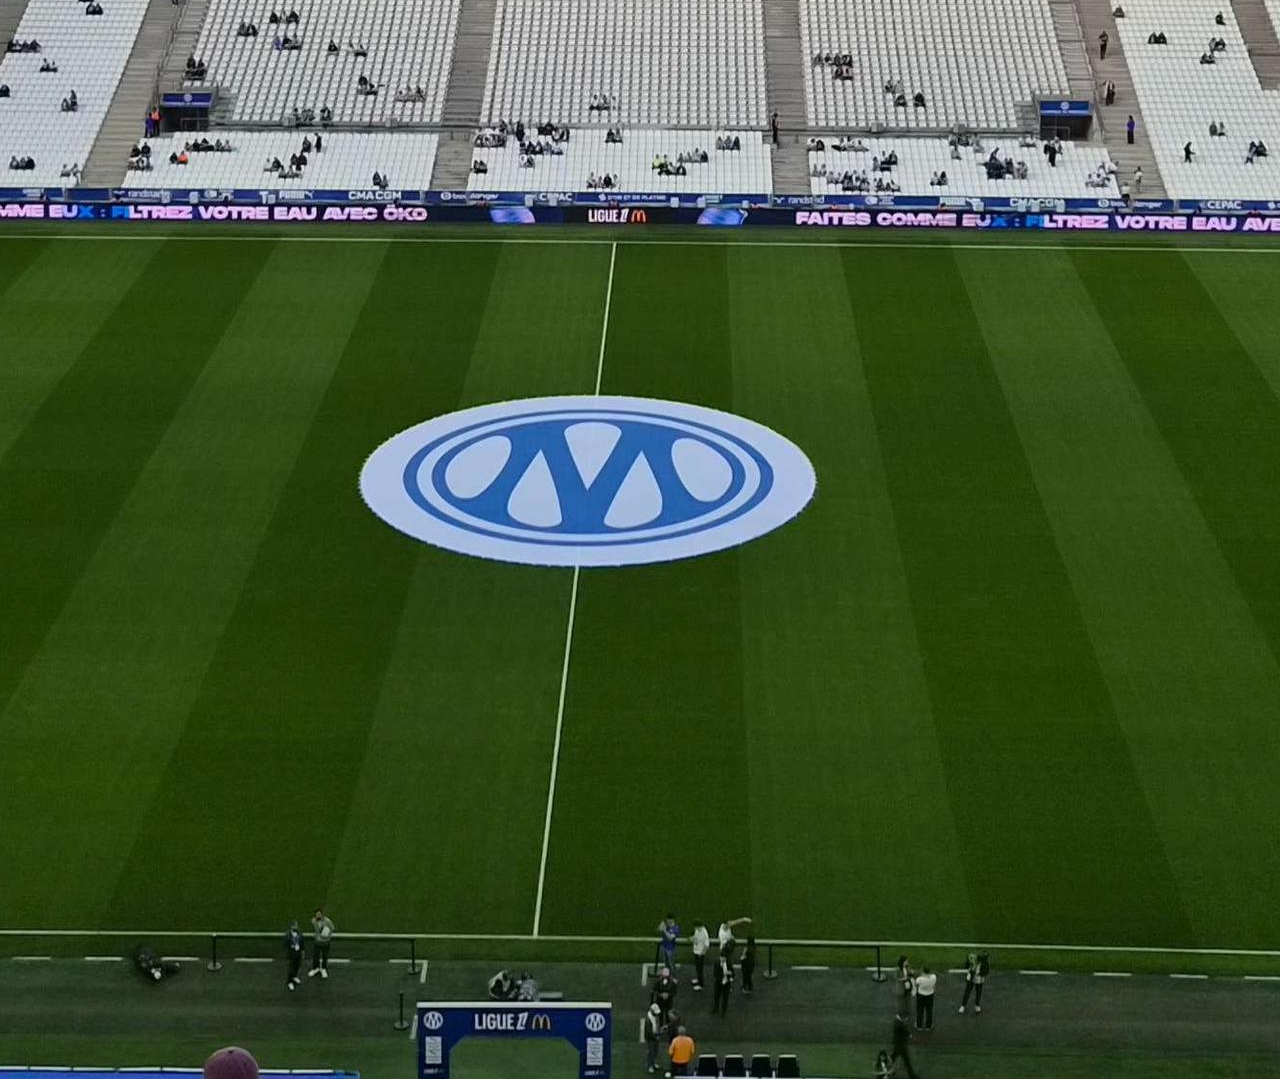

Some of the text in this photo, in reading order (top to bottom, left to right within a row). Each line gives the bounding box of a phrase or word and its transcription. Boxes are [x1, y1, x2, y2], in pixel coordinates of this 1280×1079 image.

[348, 191, 402, 200] CMA CGM
[49, 203, 94, 218] EUX
[112, 204, 192, 219] FILTREZ
[199, 205, 269, 220] VOTRE
[274, 205, 317, 220] EAU
[322, 205, 378, 220] AVEC
[383, 202, 428, 221] ÖKO
[1207, 200, 1242, 209] CEPAC
[588, 209, 618, 223] LIGUE
[795, 211, 871, 226] FAITES
[877, 211, 956, 227] COMME
[962, 212, 1006, 227] EUX
[1026, 214, 1109, 229] FILTREZ
[1115, 216, 1186, 230] VOTRE
[1192, 216, 1237, 231] EAU
[474, 1013, 515, 1030] LIGUE
